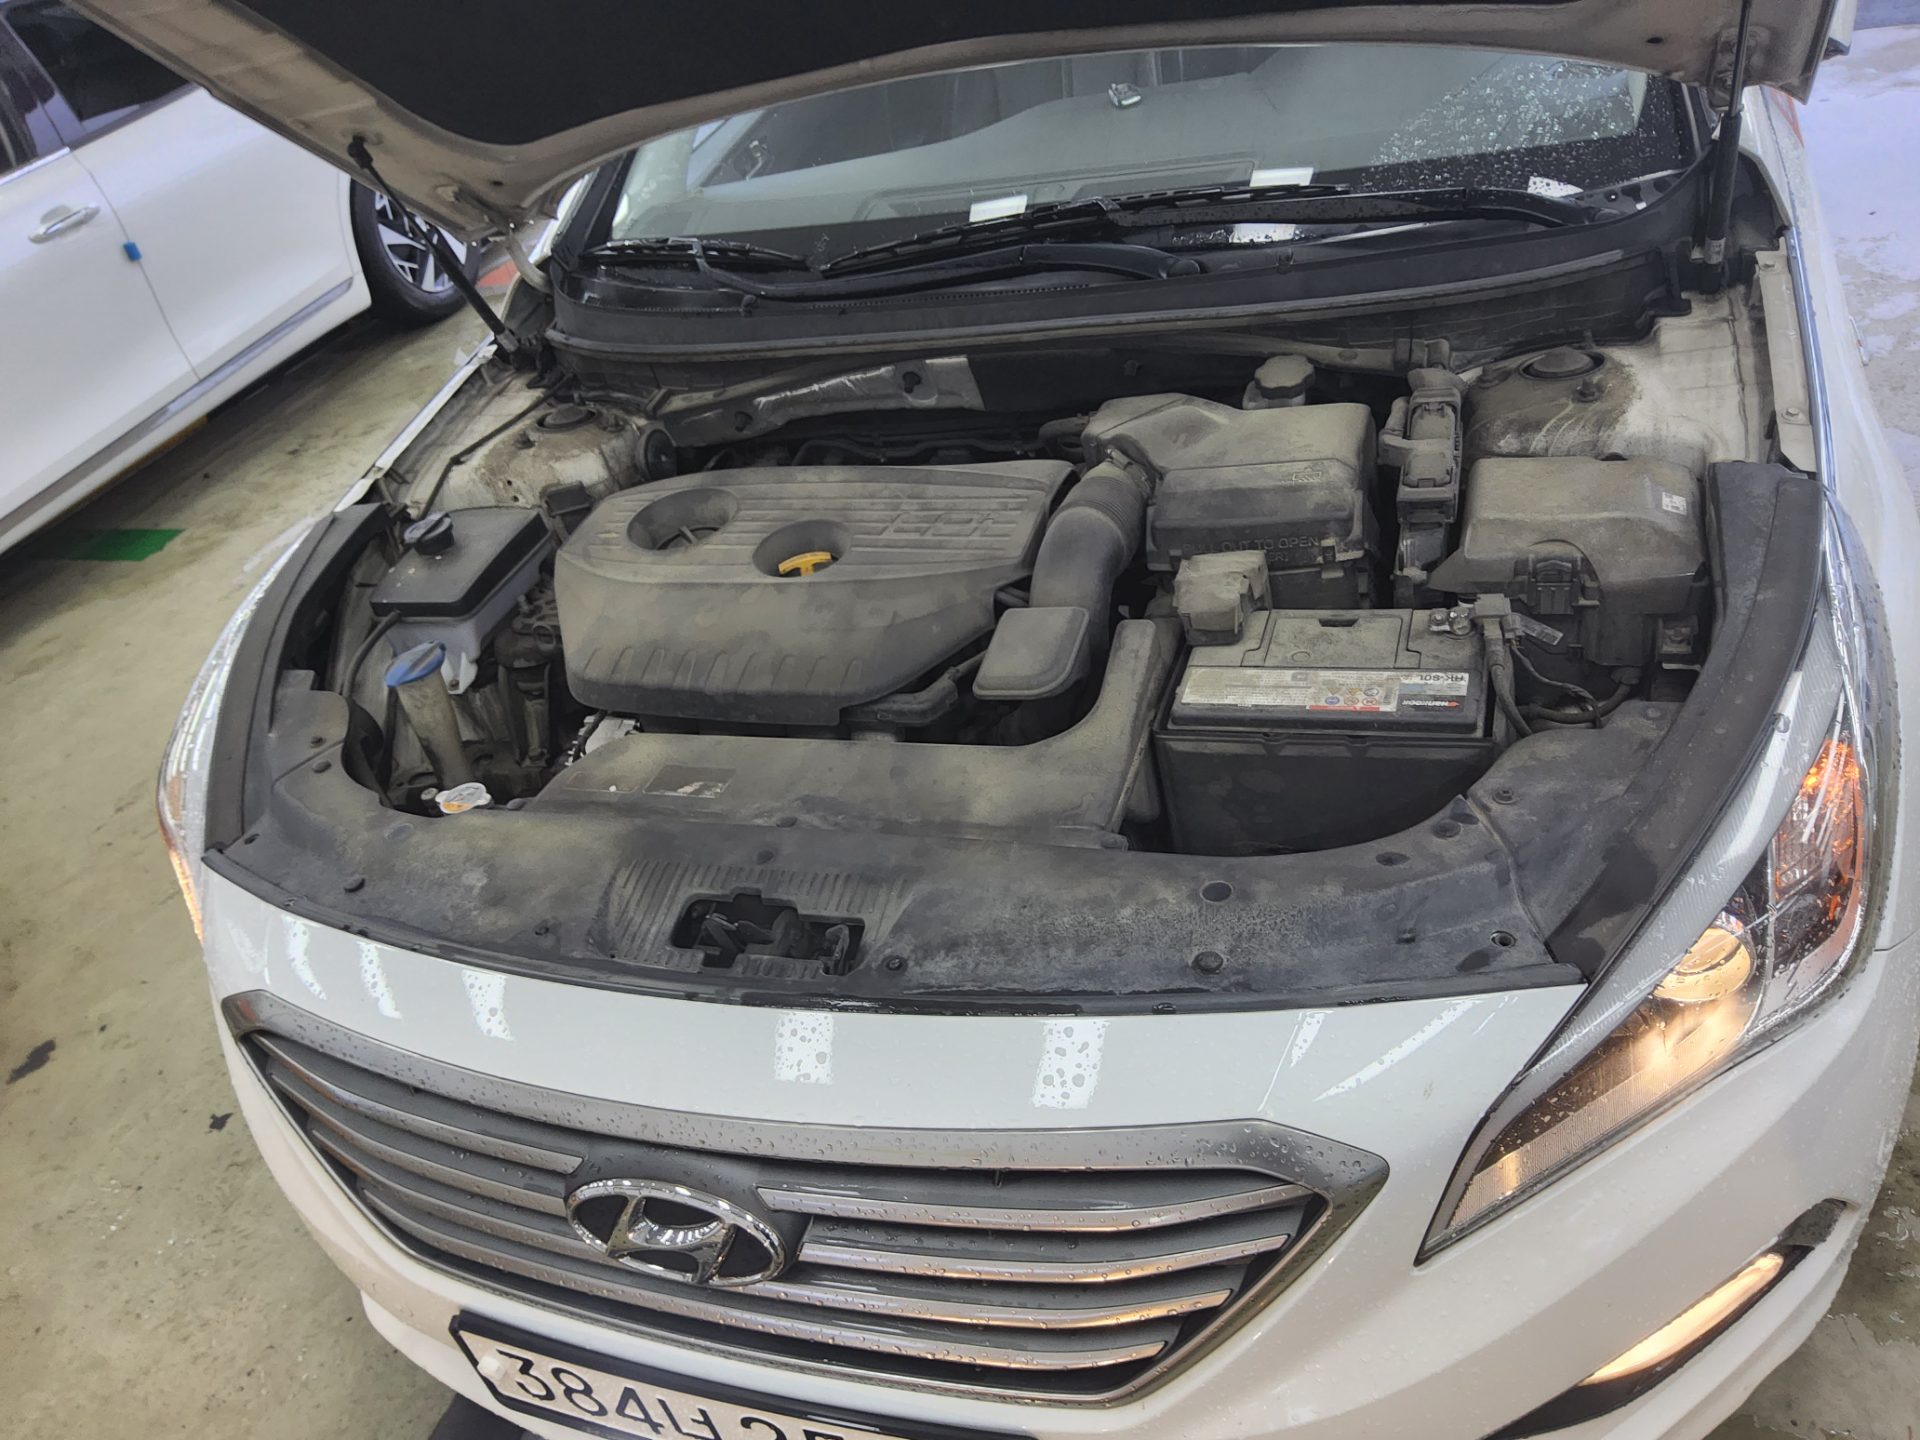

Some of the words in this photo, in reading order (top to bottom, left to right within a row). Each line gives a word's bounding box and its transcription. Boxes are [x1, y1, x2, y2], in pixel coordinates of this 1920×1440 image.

[1221, 540, 1250, 551] OUT
[1254, 537, 1274, 550] TO
[1278, 535, 1321, 549] OPEN
